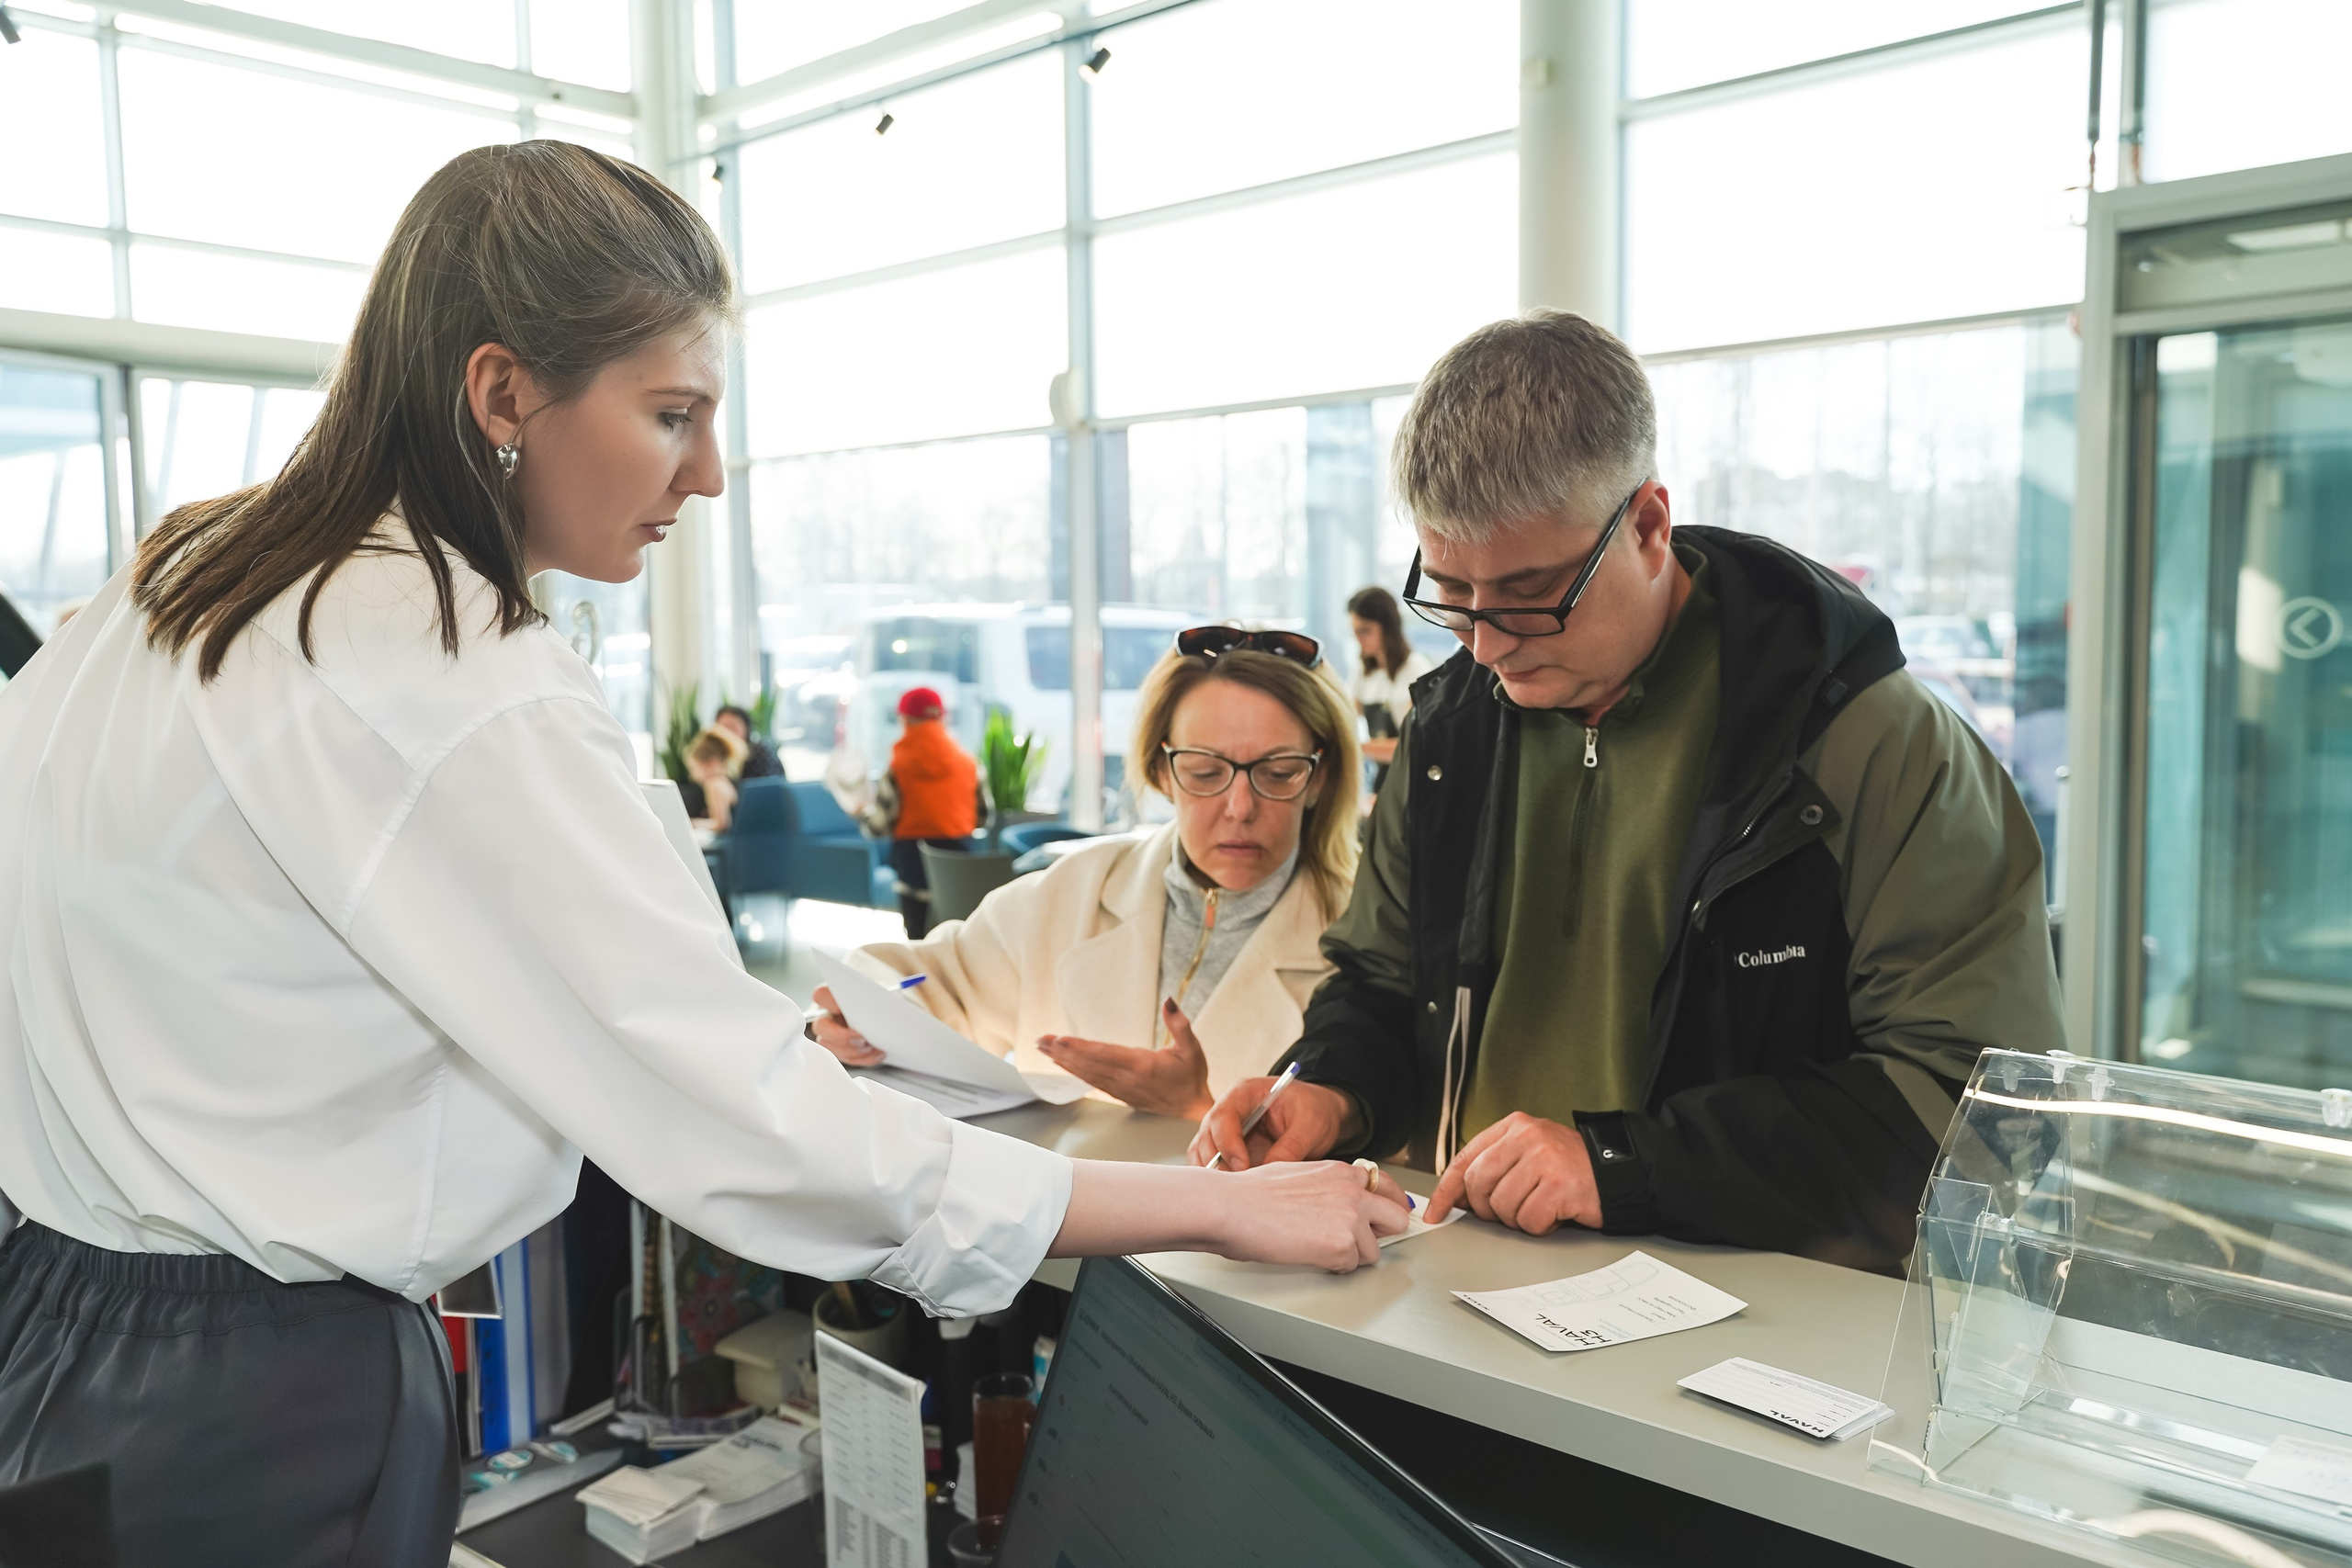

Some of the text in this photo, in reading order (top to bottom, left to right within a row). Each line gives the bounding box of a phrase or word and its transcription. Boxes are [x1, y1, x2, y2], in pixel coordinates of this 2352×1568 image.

[1738, 944, 1806, 968] Columbia
[1534, 1313, 1596, 1347] HAVAL
[1585, 1328, 1612, 1344] H3
[1770, 1409, 1825, 1433] HAVAL
